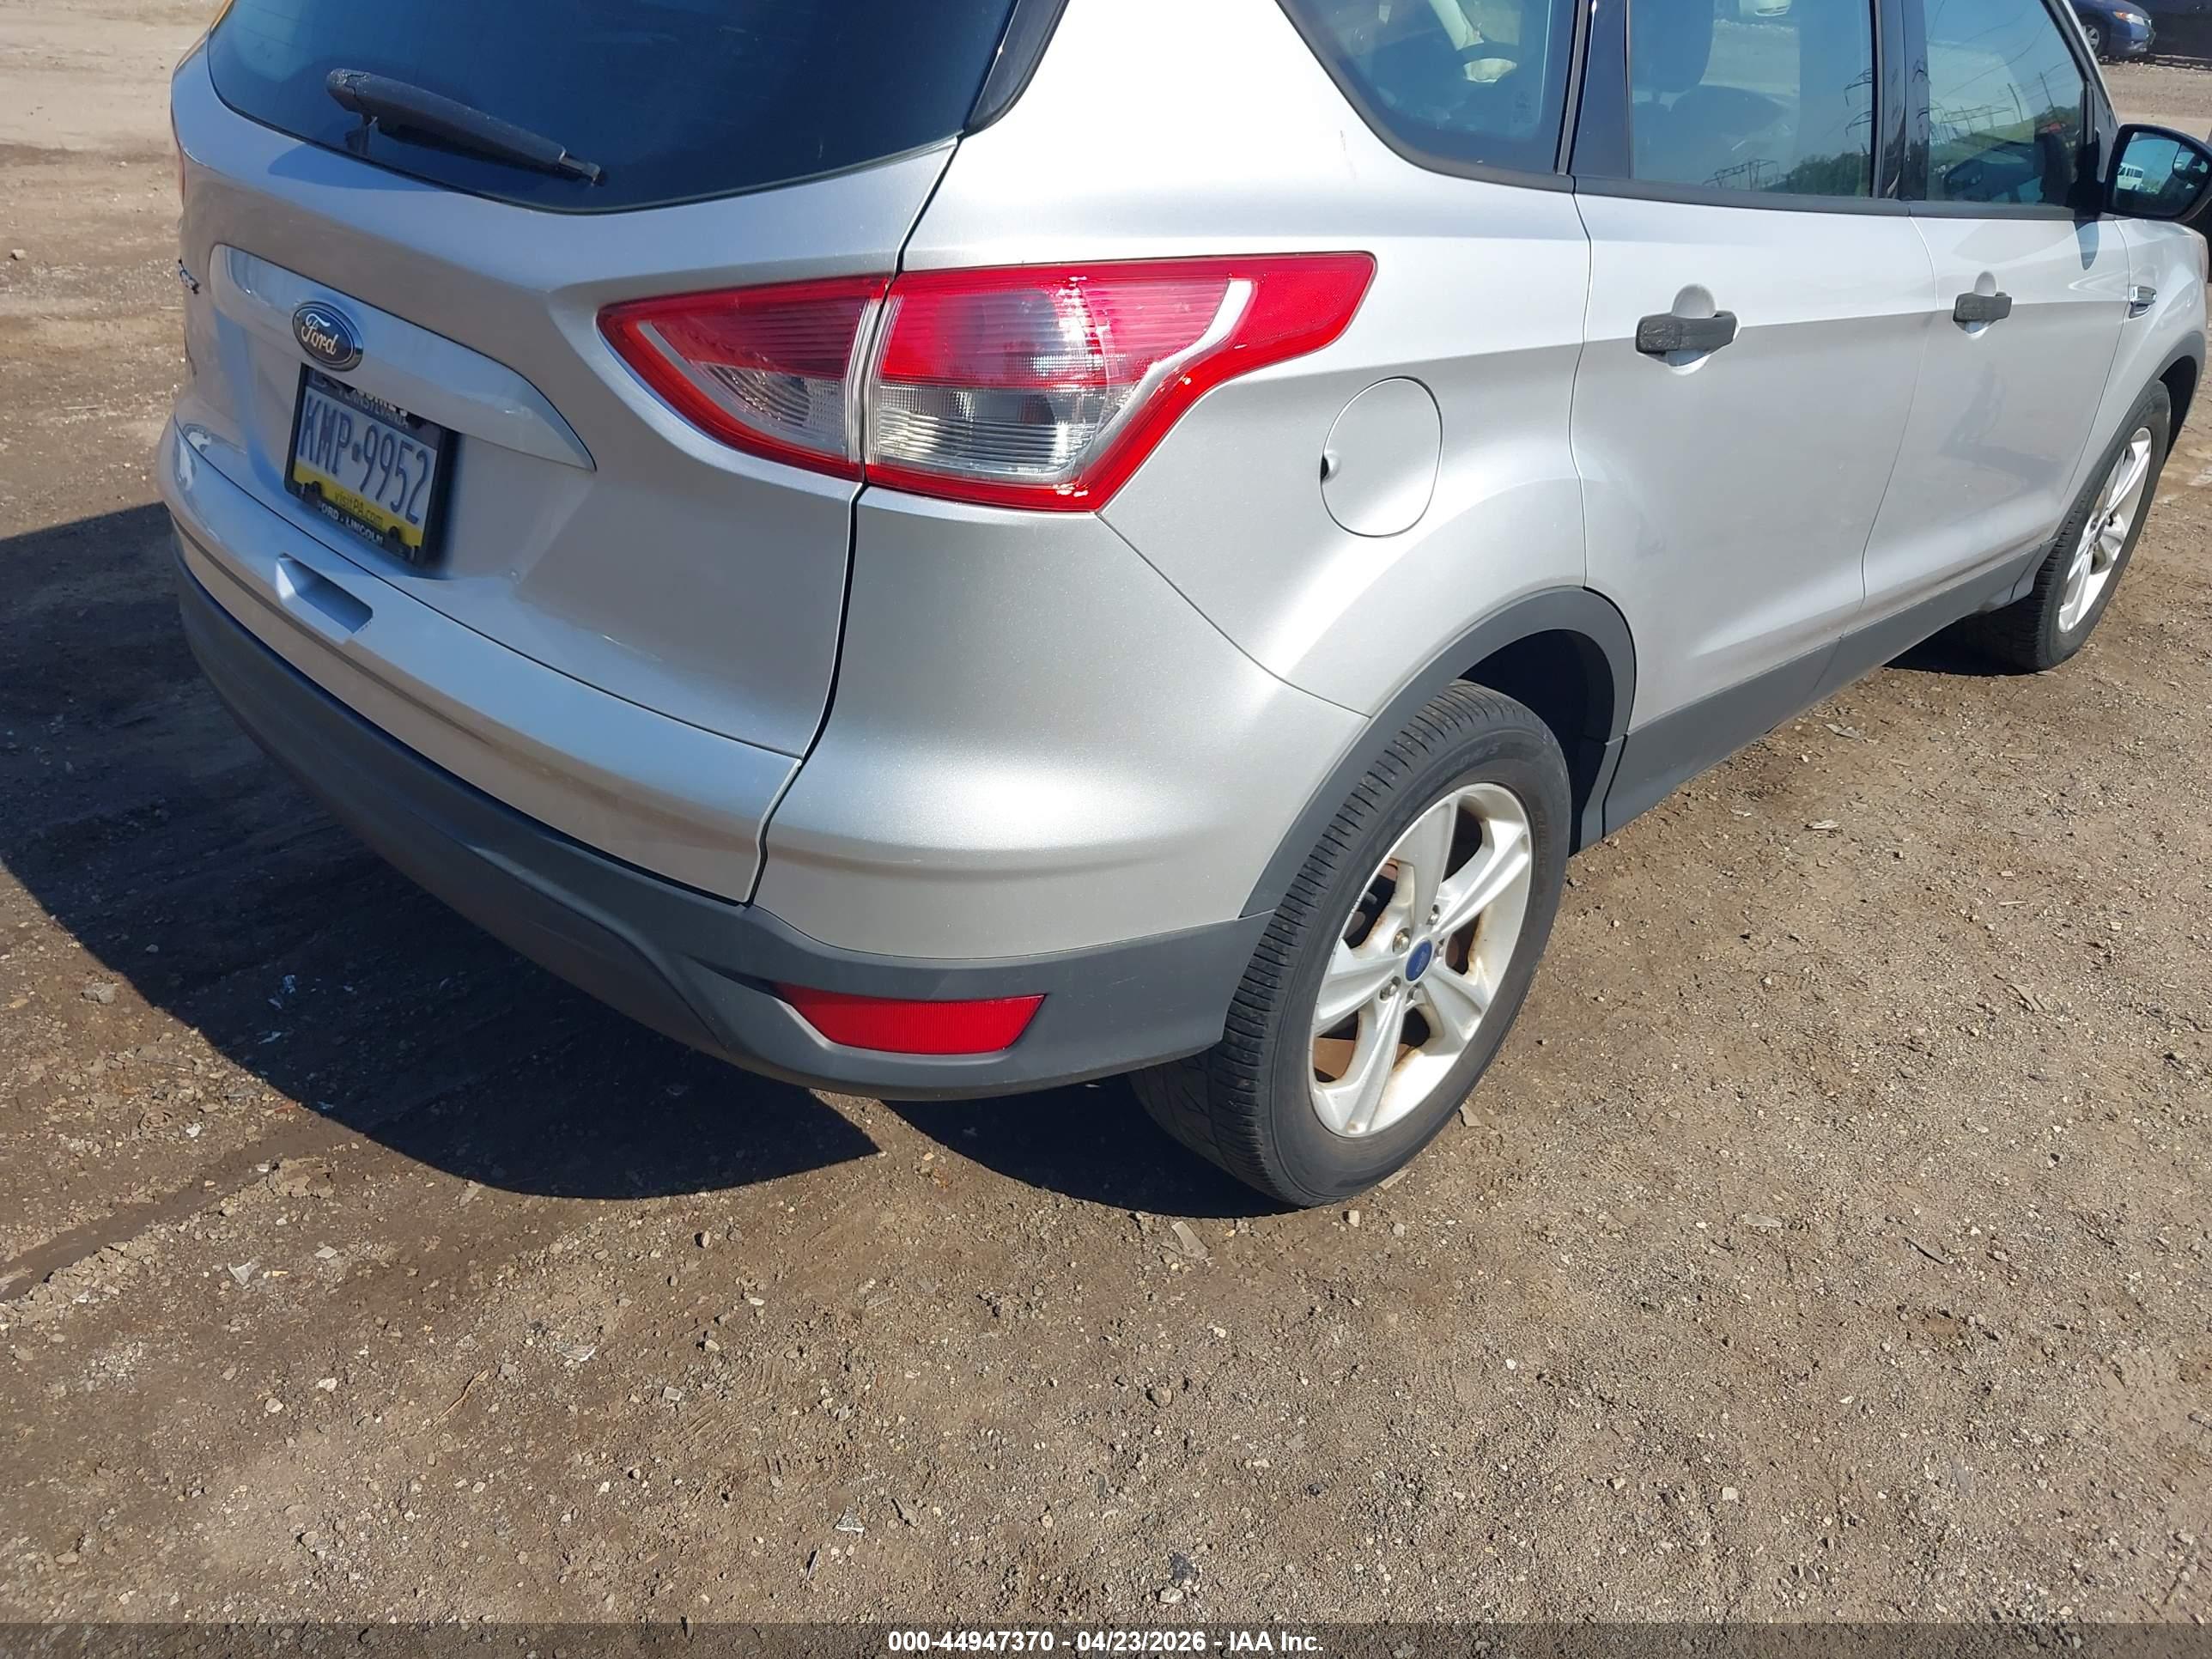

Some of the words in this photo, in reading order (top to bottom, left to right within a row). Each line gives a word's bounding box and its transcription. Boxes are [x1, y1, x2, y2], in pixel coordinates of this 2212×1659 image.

[301, 313, 337, 356] Ford
[334, 489, 384, 528] visitPA.com
[344, 515, 384, 544] LINCOLN
